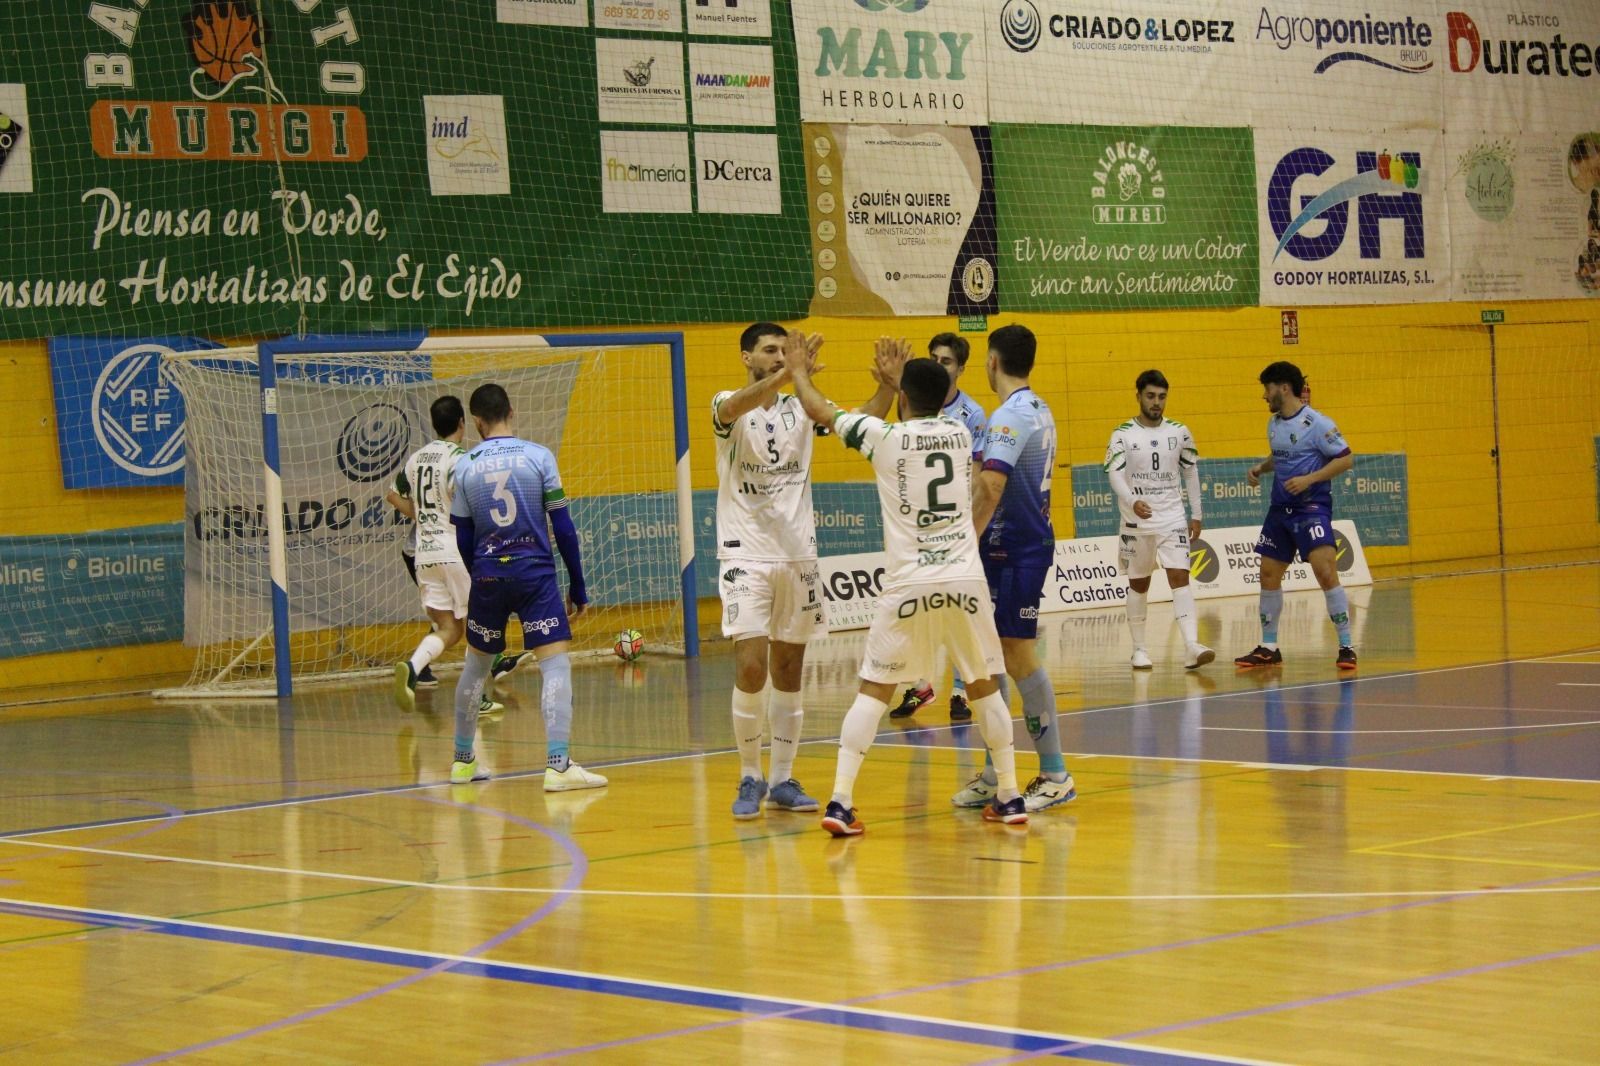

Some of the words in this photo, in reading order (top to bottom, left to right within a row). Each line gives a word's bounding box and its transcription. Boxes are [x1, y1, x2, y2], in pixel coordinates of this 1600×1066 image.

[626, 8, 639, 18] 92
[641, 9, 655, 19] 20
[658, 10, 670, 20] 95
[695, 14, 725, 22] Manuel
[727, 14, 757, 24] Fuentes
[1507, 14, 1559, 27] PLÁSTICO
[1256, 7, 1432, 50] Agroponiente
[815, 27, 974, 80] MARY
[1072, 41, 1116, 51] SOLUCIONES
[1118, 43, 1168, 52] AGROTEXTILES
[1400, 50, 1428, 62] GRUPO
[696, 73, 770, 88] NAANDANJAIN
[823, 90, 964, 109] HERBOLARIO
[110, 105, 351, 157] MURGI
[432, 116, 468, 138] imd
[1091, 141, 1165, 198] BALONCESTO
[852, 190, 900, 209] ¿QUIÉN
[904, 193, 951, 207] QUIERE
[81, 187, 211, 250] Piensa
[223, 208, 259, 236] en
[271, 189, 387, 242] Verde,
[848, 211, 869, 225] SER
[874, 211, 962, 226] MILLONARIO?
[1099, 207, 1161, 222] MURGI
[1013, 237, 1037, 262] El
[1039, 236, 1102, 262] Verde
[1106, 244, 1135, 261] no
[1138, 243, 1160, 263] es
[1162, 244, 1192, 261] un
[1195, 235, 1247, 260] Color
[119, 256, 327, 304] Hortalizas
[339, 258, 374, 302] de
[386, 253, 425, 301] El
[436, 253, 522, 317] Ejido
[1030, 273, 1077, 297] sino
[1080, 275, 1114, 295] un
[1114, 270, 1239, 295] Sentimiento
[1273, 271, 1323, 286] GODOY
[1327, 270, 1411, 286] HORTALIZAS,
[1414, 270, 1435, 285] S.L.
[767, 439, 780, 464] 5
[470, 456, 526, 476] JOSETE
[1152, 452, 1159, 471] 8
[417, 466, 436, 508] 12
[925, 452, 956, 512] 2
[1213, 481, 1262, 499] Bioline
[1356, 477, 1401, 493] Bioline
[483, 470, 517, 527] 3
[626, 521, 680, 540] Biolin
[1309, 525, 1325, 540] 10
[88, 554, 165, 578] Bioline
[1055, 561, 1117, 582] Antonio
[1294, 569, 1307, 579] 58
